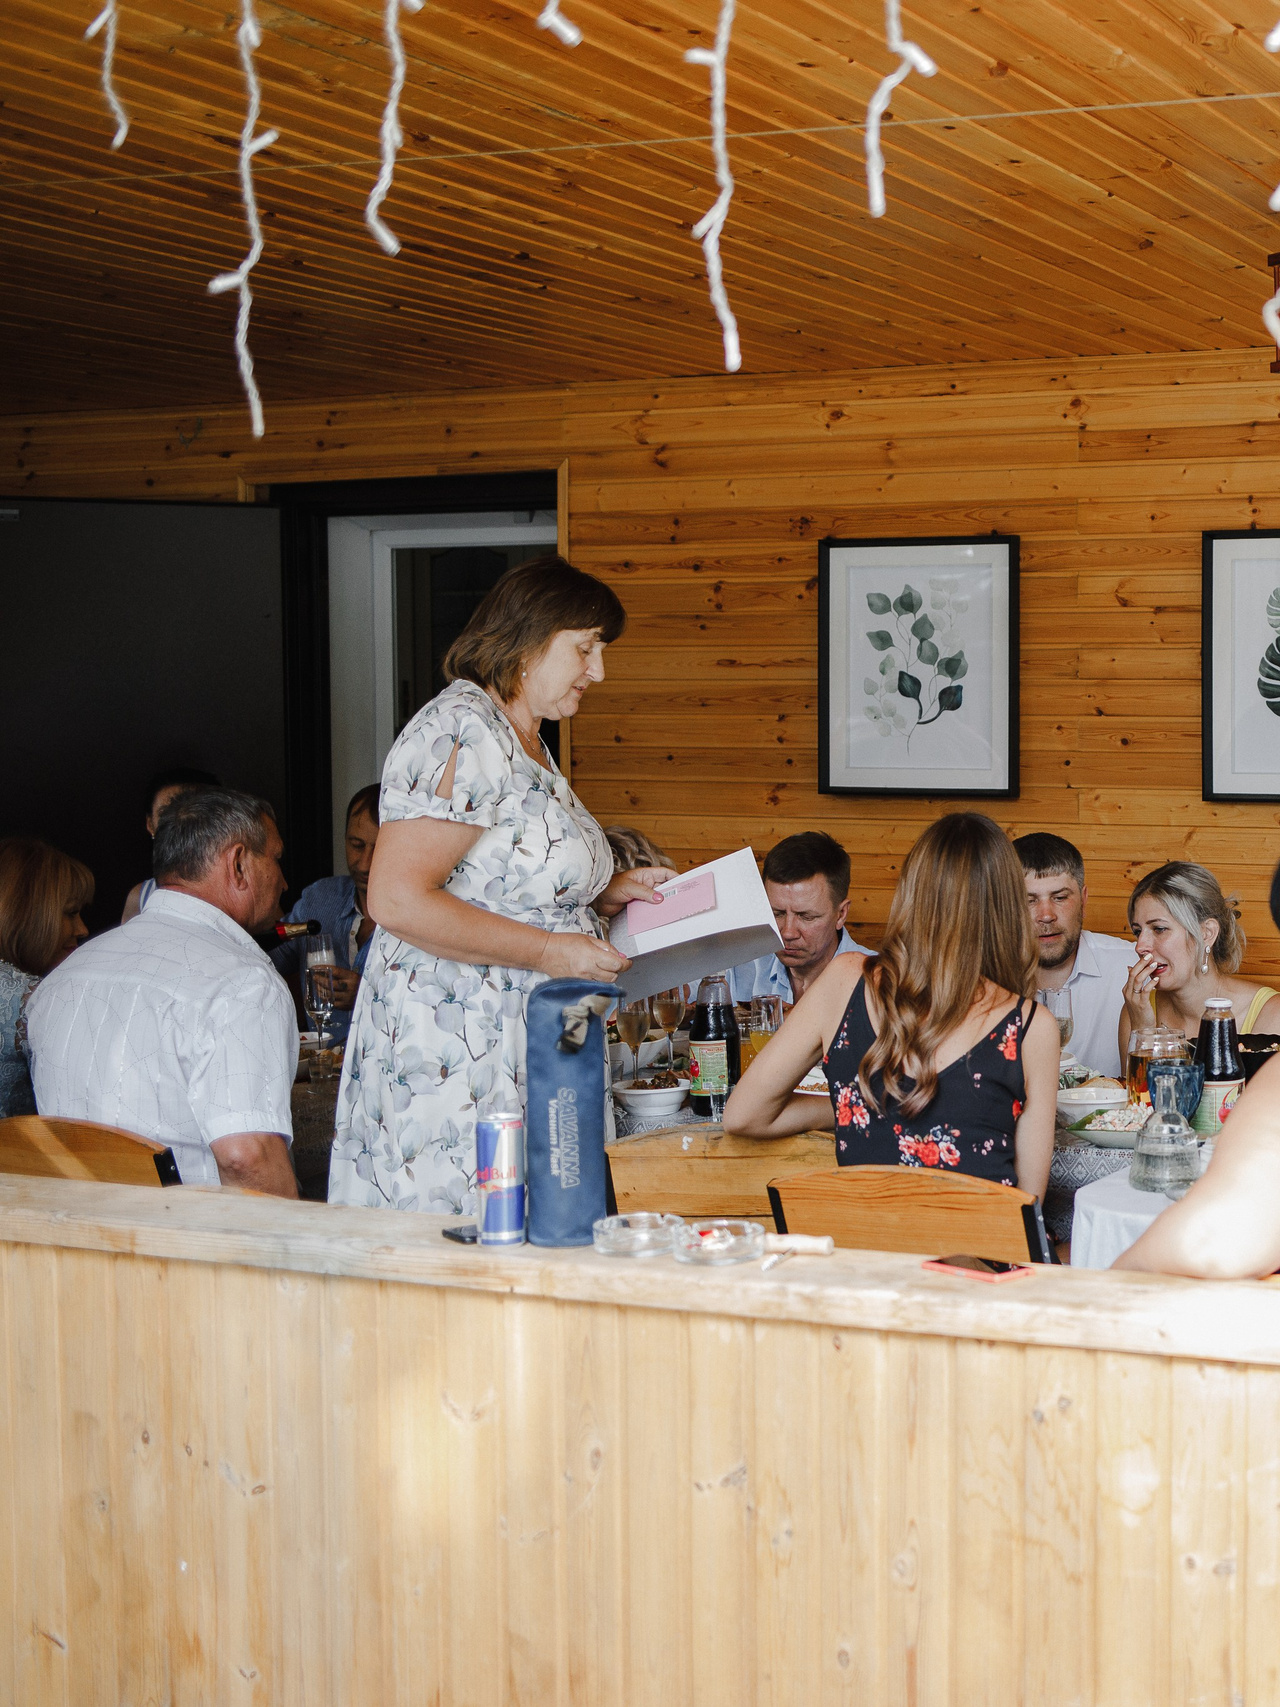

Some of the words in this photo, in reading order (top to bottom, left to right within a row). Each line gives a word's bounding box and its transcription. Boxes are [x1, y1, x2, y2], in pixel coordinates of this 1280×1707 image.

[548, 1099, 559, 1145] Vacuum
[557, 1087, 581, 1189] SAVANNA
[490, 1166, 517, 1180] Bull
